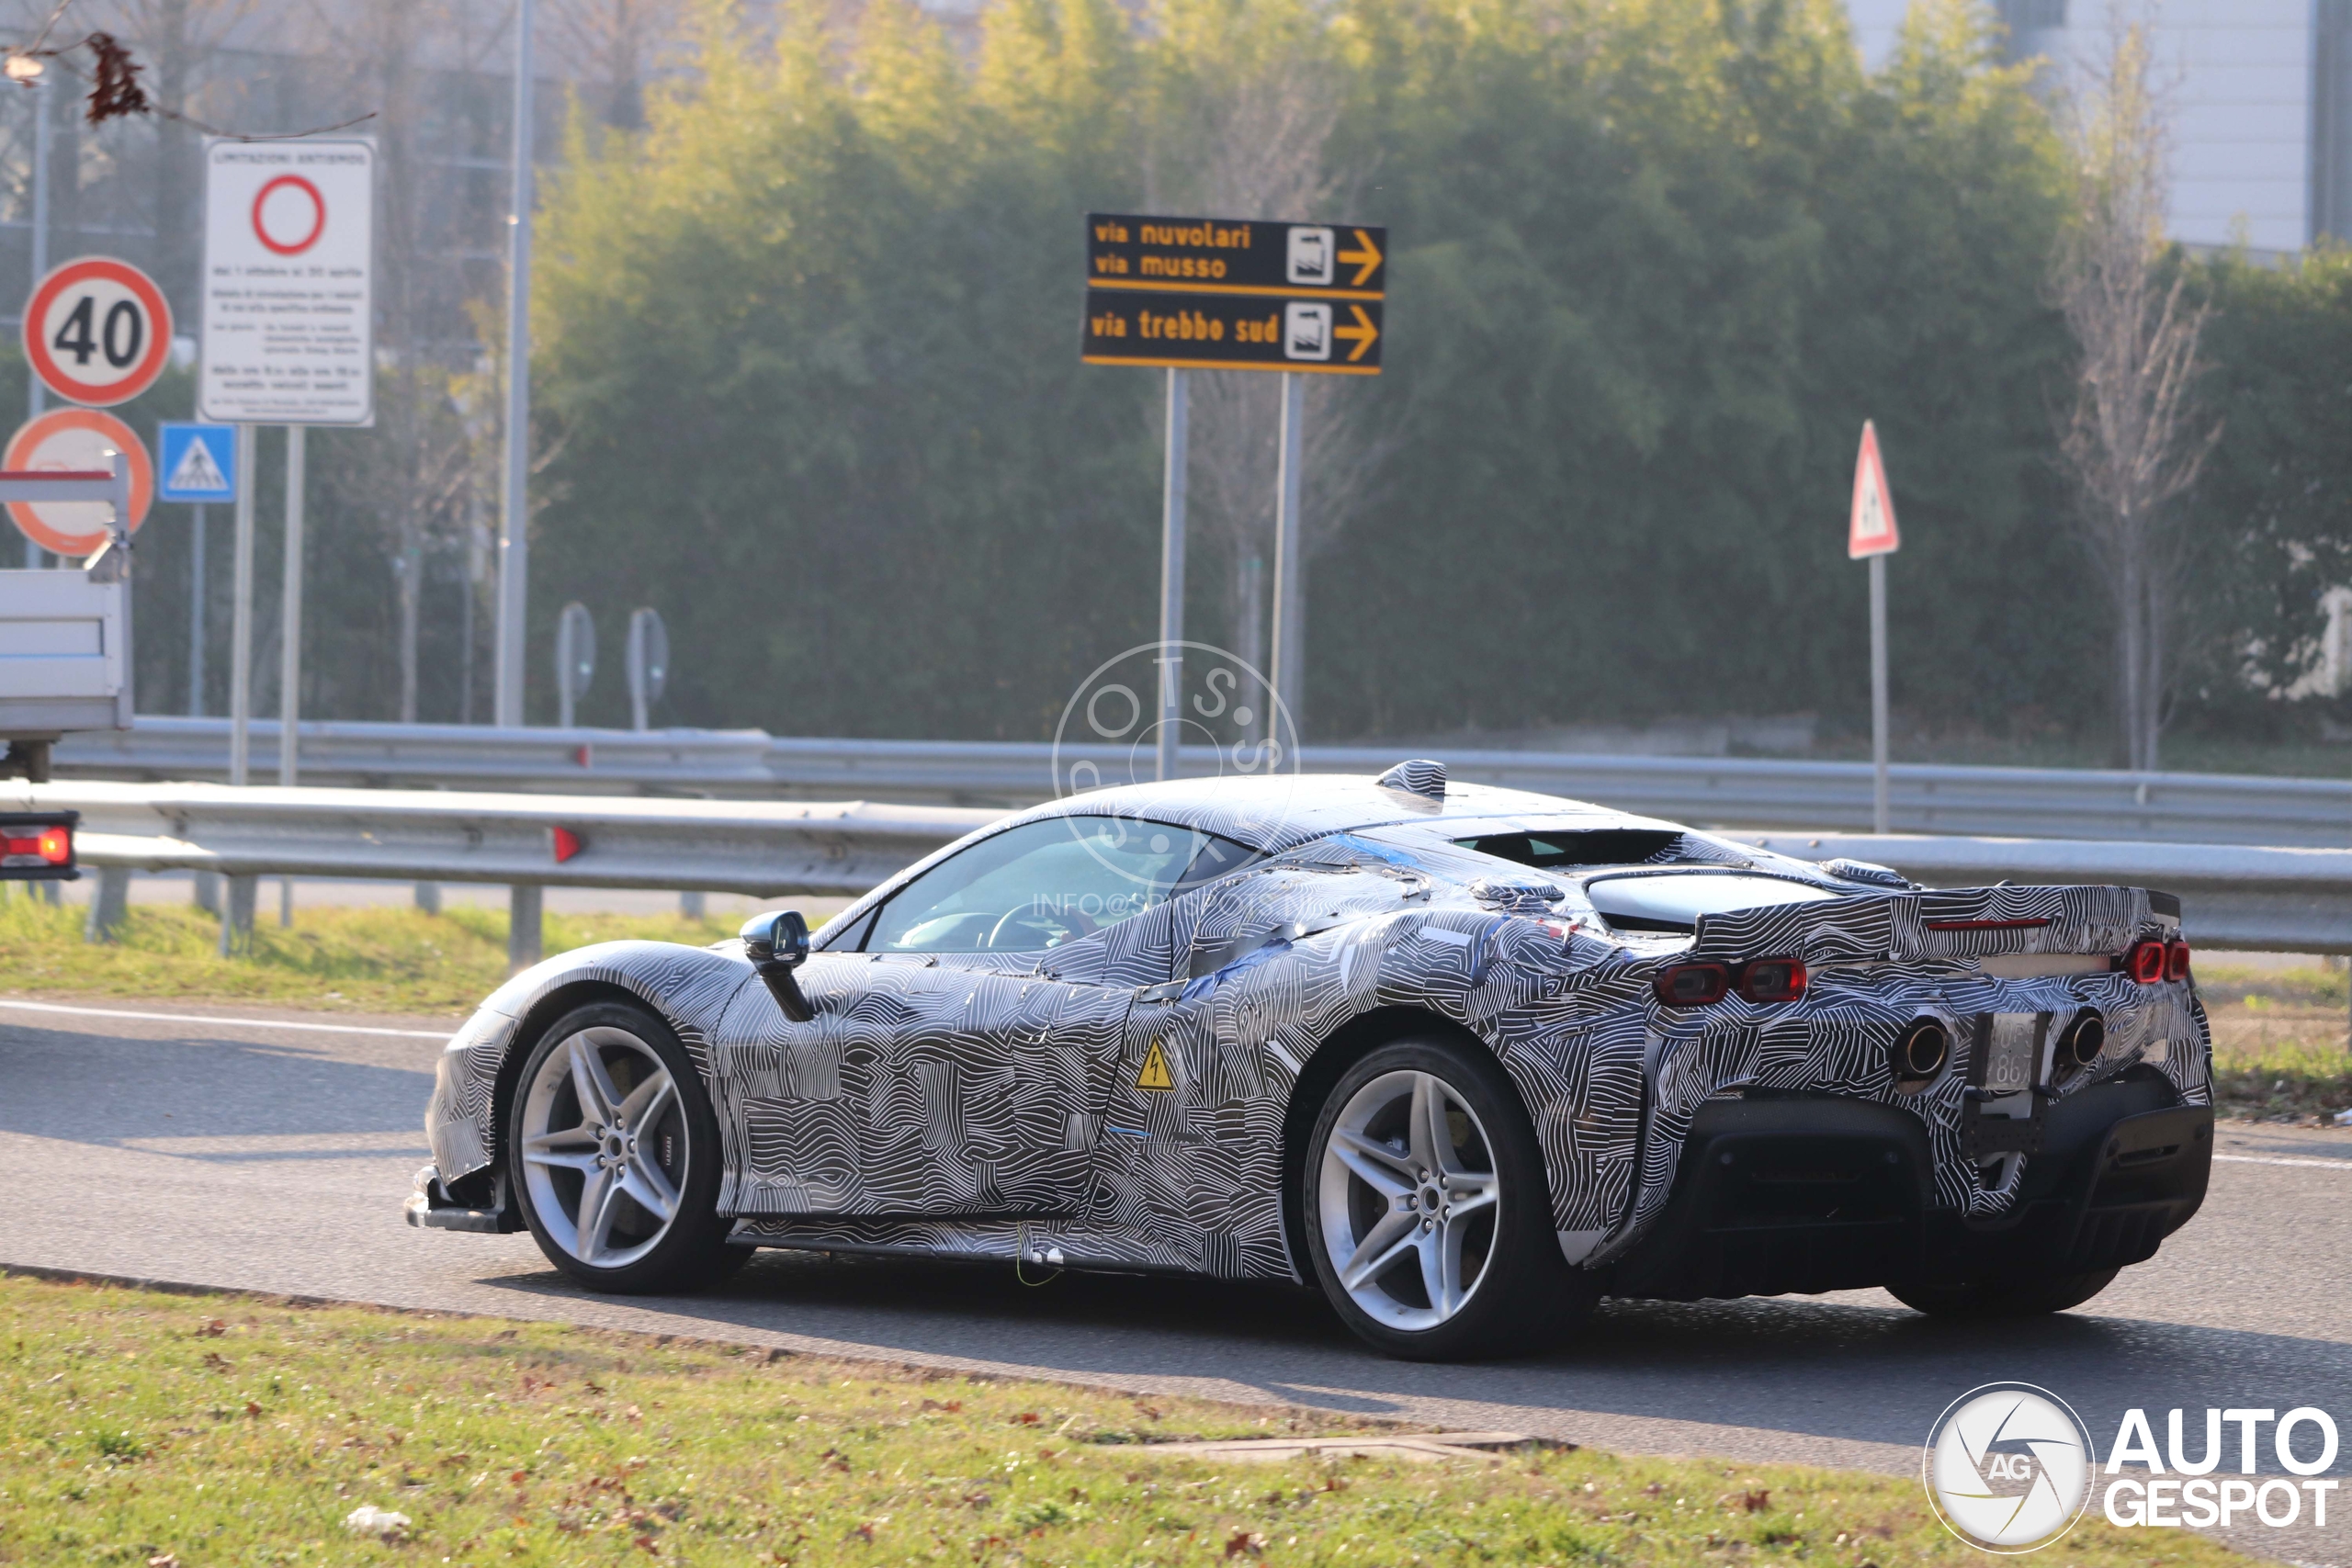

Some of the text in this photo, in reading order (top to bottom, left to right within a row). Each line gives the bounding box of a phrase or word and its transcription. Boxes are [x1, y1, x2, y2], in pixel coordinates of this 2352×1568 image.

[1095, 222, 1251, 249] via nuvolari
[1095, 254, 1227, 278] via musso
[54, 296, 143, 368] 40
[1091, 310, 1279, 344] via trebbo sud
